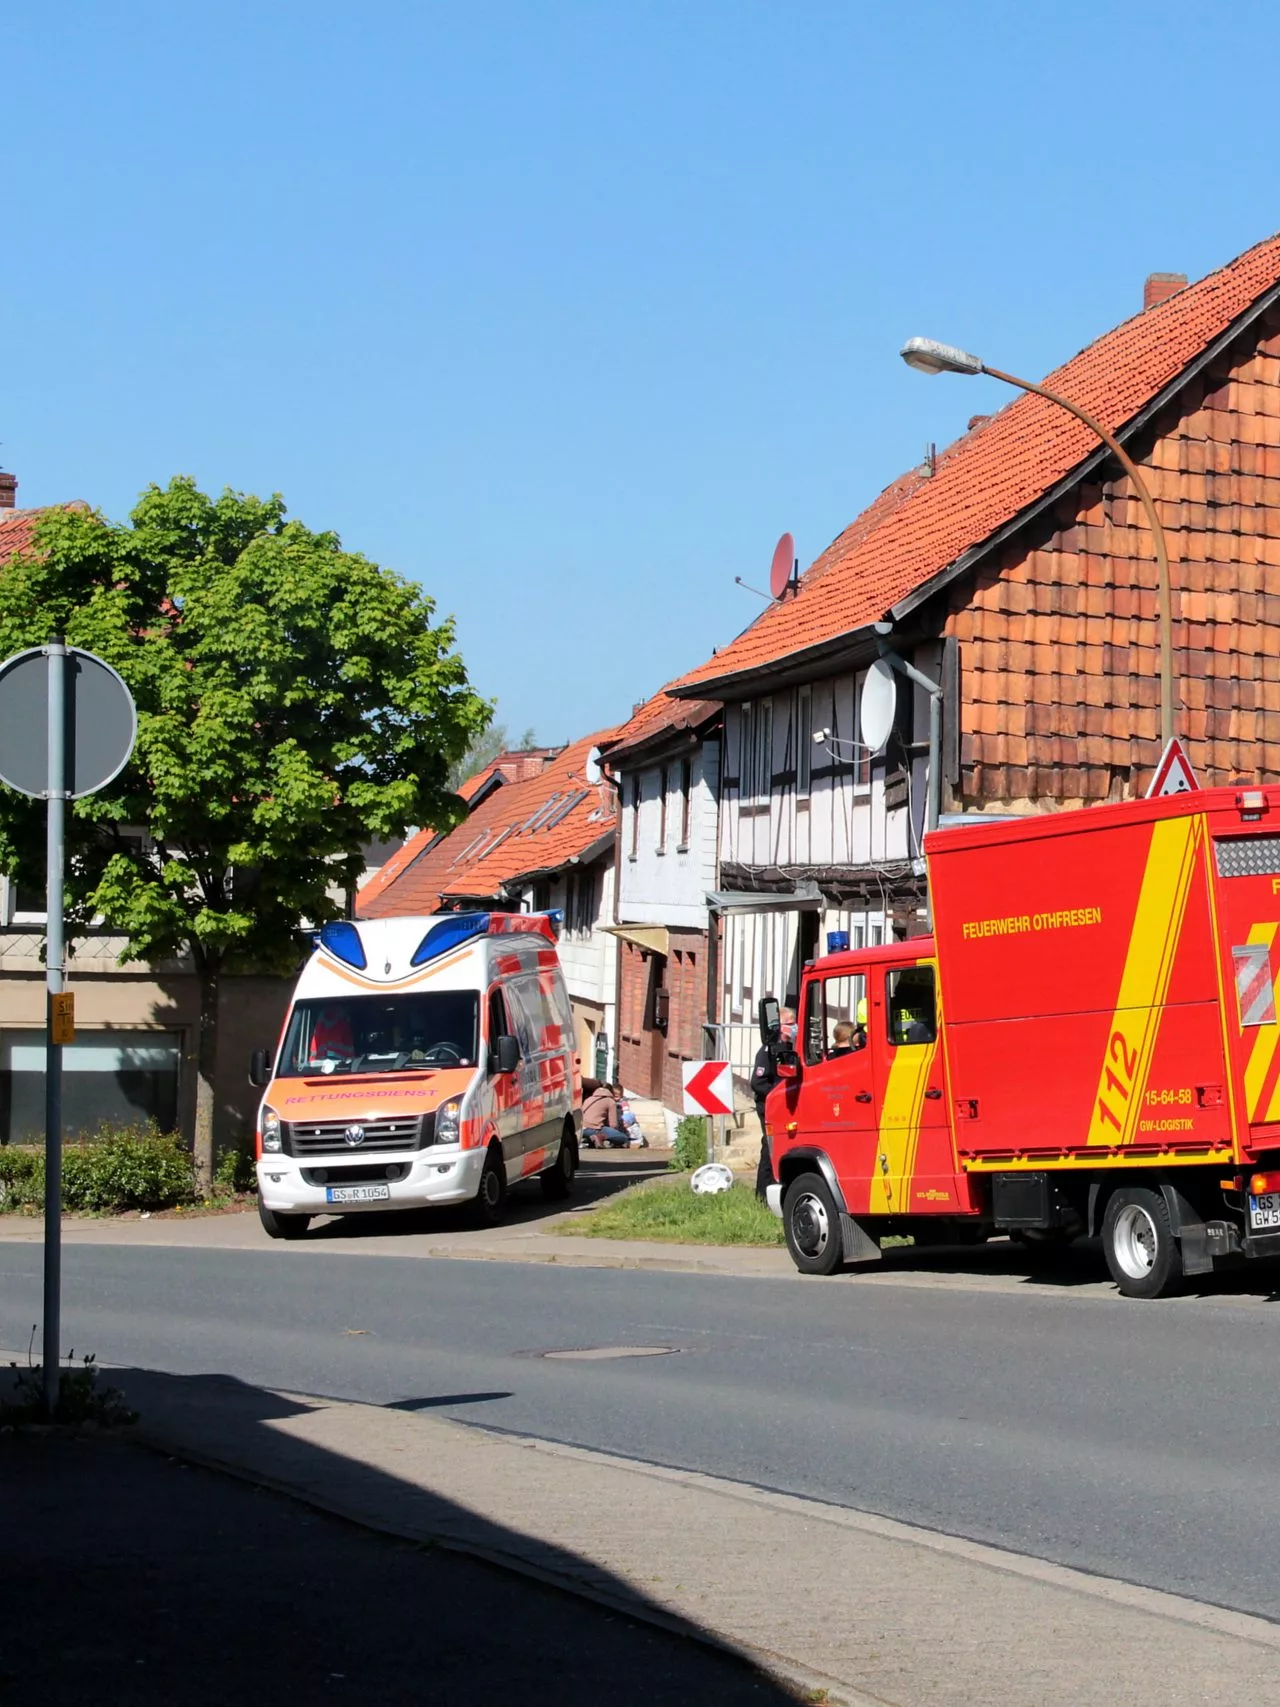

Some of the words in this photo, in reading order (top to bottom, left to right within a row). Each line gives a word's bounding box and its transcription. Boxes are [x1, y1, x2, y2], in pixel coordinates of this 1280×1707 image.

[963, 916, 1032, 940] FEUERWEHR
[1033, 907, 1102, 931] OTHFRESEN
[1098, 1031, 1138, 1134] 112
[285, 1089, 439, 1105] RETTUNGSDIENST
[1145, 1089, 1192, 1106] 15-64-58
[1140, 1118, 1194, 1132] GW-LOGISTIK
[1259, 1195, 1274, 1211] GS
[1255, 1211, 1270, 1226] GW
